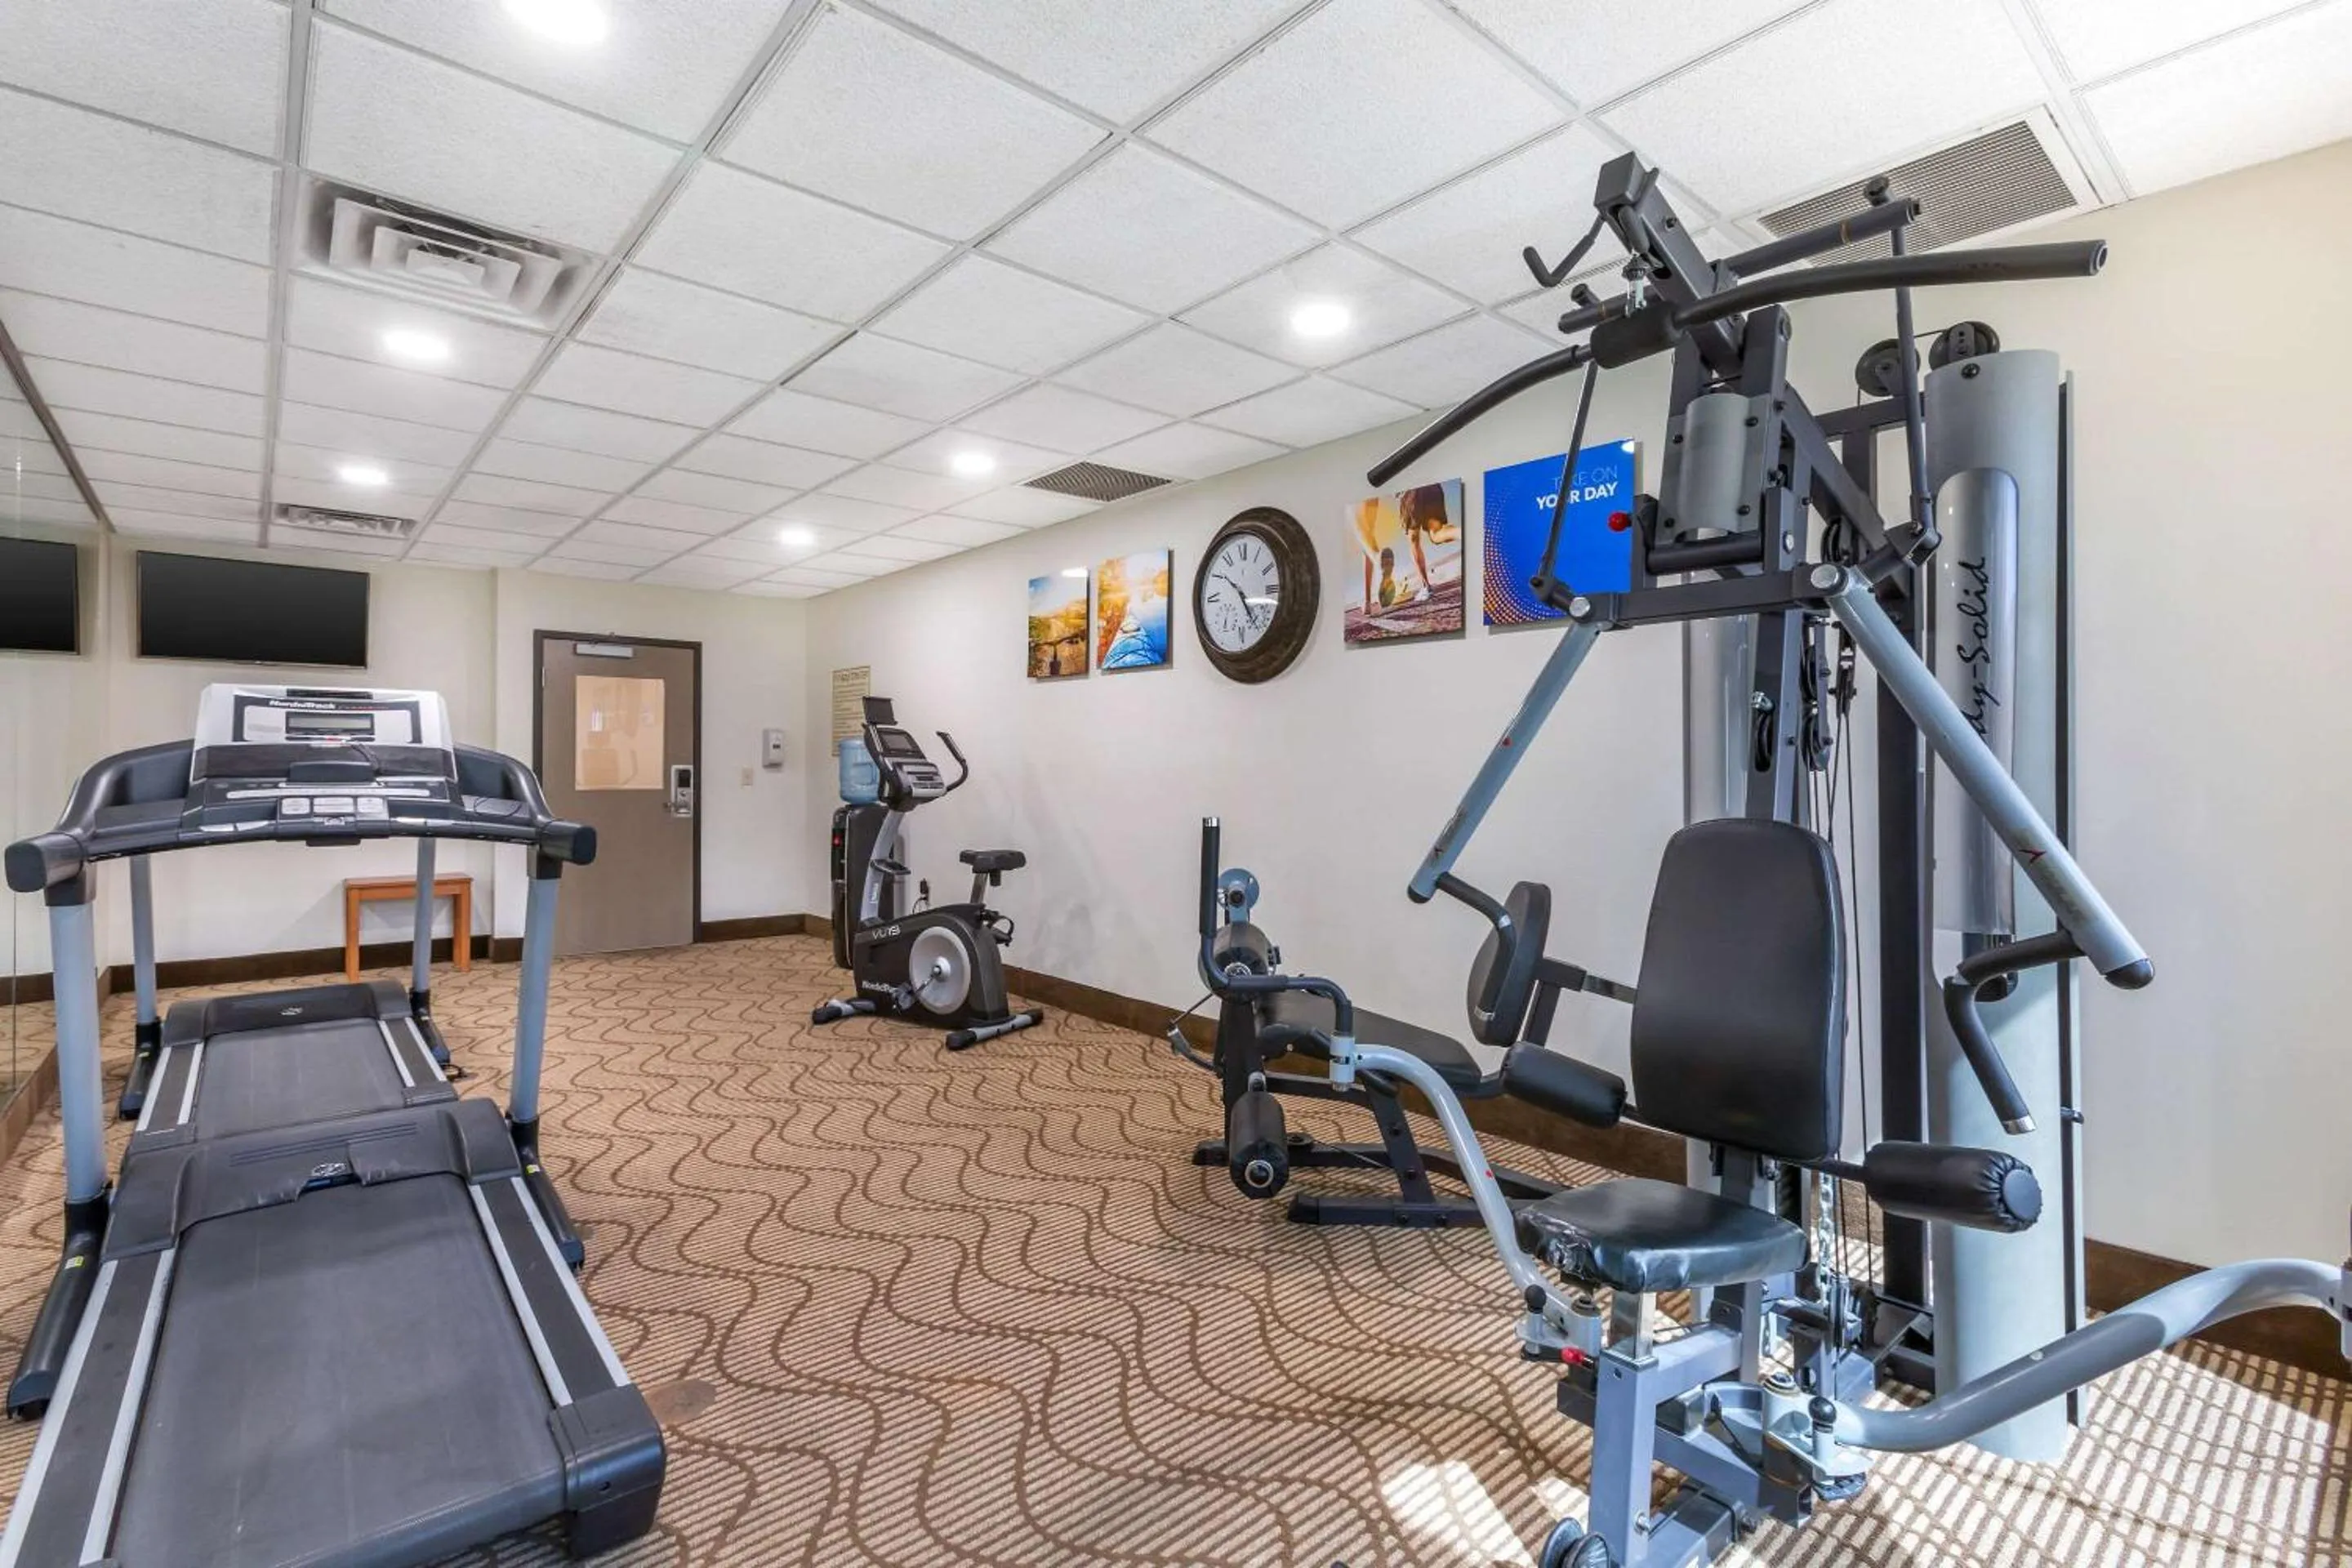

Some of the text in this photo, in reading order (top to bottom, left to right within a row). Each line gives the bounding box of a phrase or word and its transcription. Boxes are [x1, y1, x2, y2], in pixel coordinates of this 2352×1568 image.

[1552, 464, 1618, 489] TKE ON
[1536, 482, 1619, 510] YOR DAY
[1956, 556, 2001, 742] dy-Solid
